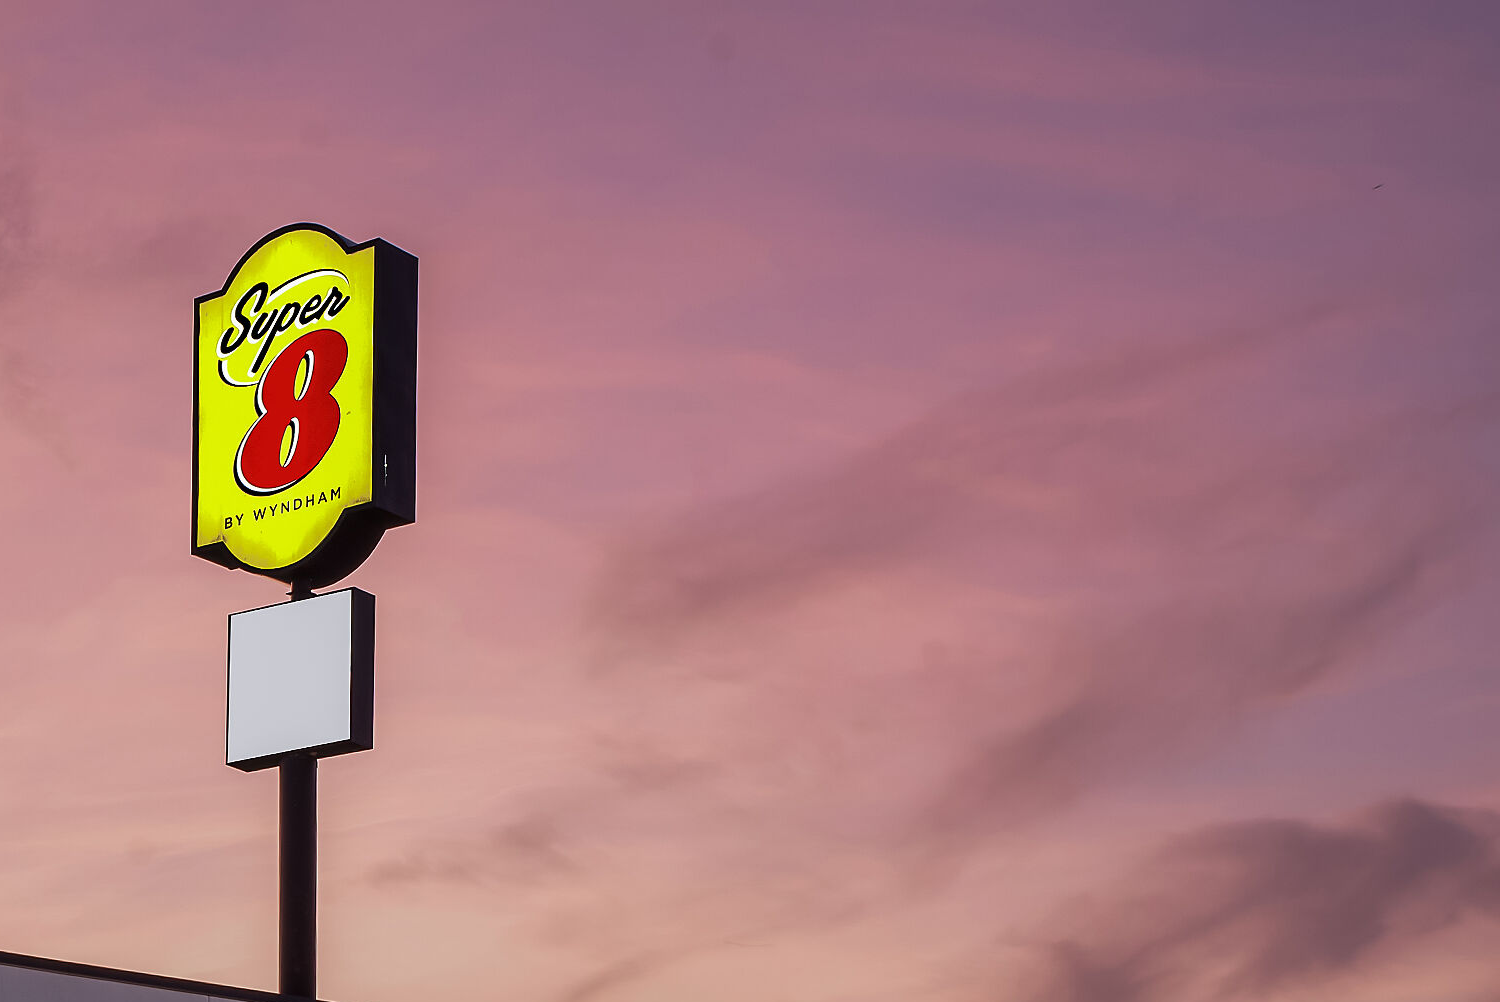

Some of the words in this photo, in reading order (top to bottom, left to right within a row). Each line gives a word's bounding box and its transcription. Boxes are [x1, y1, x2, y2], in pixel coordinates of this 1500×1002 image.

[217, 281, 350, 376] Super
[234, 328, 349, 496] 8
[224, 513, 244, 529] BY
[253, 487, 341, 521] WYNDHAM
